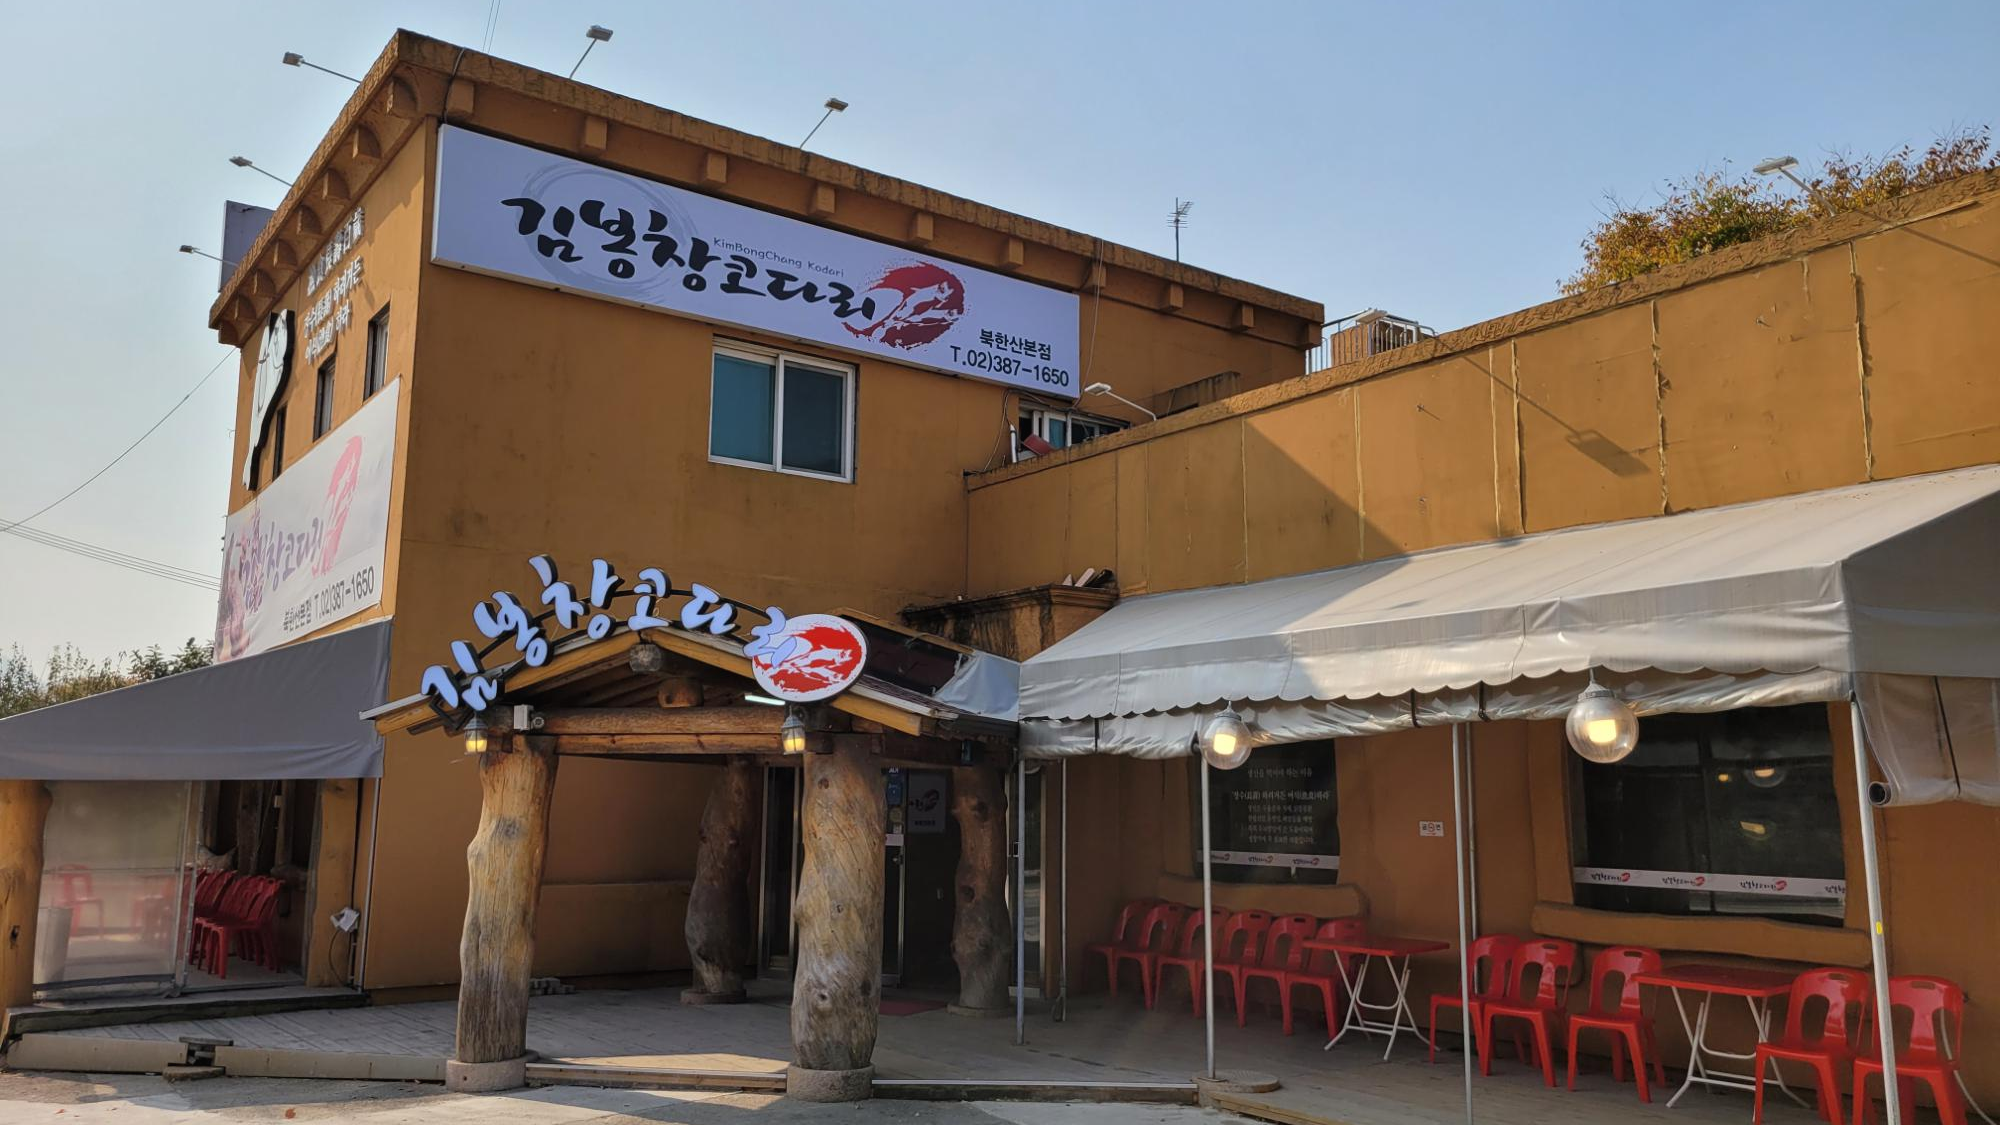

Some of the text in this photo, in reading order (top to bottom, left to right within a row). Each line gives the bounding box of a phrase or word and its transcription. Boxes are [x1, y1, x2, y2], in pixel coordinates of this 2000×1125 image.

[333, 255, 362, 304] 하려거든
[501, 197, 875, 322] 김봉창코다리
[712, 236, 846, 279] KimBongChang Kodari
[950, 344, 1070, 387] T.02)387-1650
[977, 327, 1053, 361] 북한산본점
[420, 554, 797, 711] 김봉창코다리
